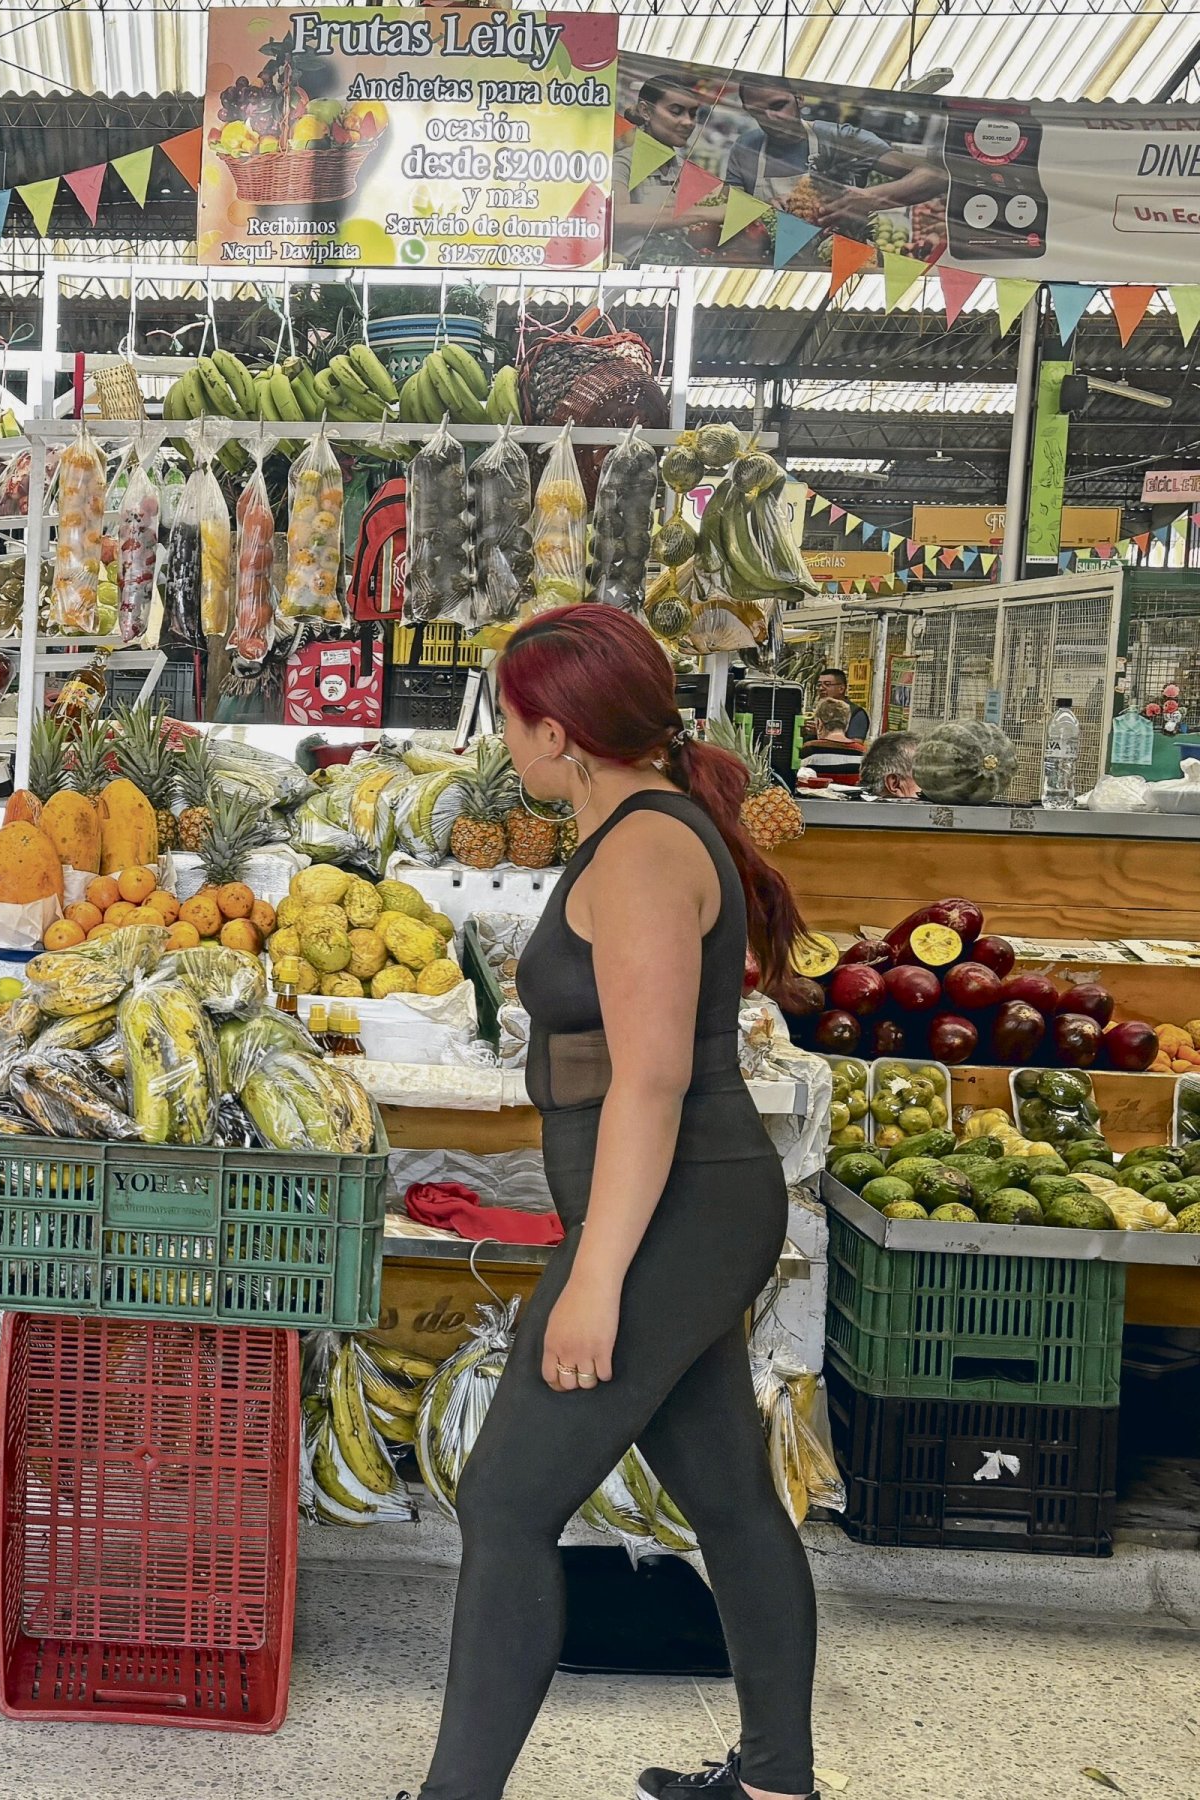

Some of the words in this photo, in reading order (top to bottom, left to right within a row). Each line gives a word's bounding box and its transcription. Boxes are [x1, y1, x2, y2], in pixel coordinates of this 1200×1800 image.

[291, 13, 432, 56] Frutas
[441, 13, 564, 70] Leidy
[348, 73, 472, 103] Anchetas
[477, 81, 541, 111] para
[547, 78, 611, 105] toda
[426, 112, 531, 143] ocasión
[403, 145, 492, 180] desde
[497, 150, 609, 184] $20.000
[462, 186, 481, 213] y
[487, 183, 539, 209] más
[247, 217, 337, 236] Recibimos
[386, 214, 465, 236] Servicio
[475, 217, 499, 237] de
[503, 217, 600, 240] domicilio
[1134, 207, 1168, 222] Un
[282, 241, 361, 264] Daviplata
[439, 244, 546, 266] 3125770889
[112, 1172, 210, 1195] YOHAN
